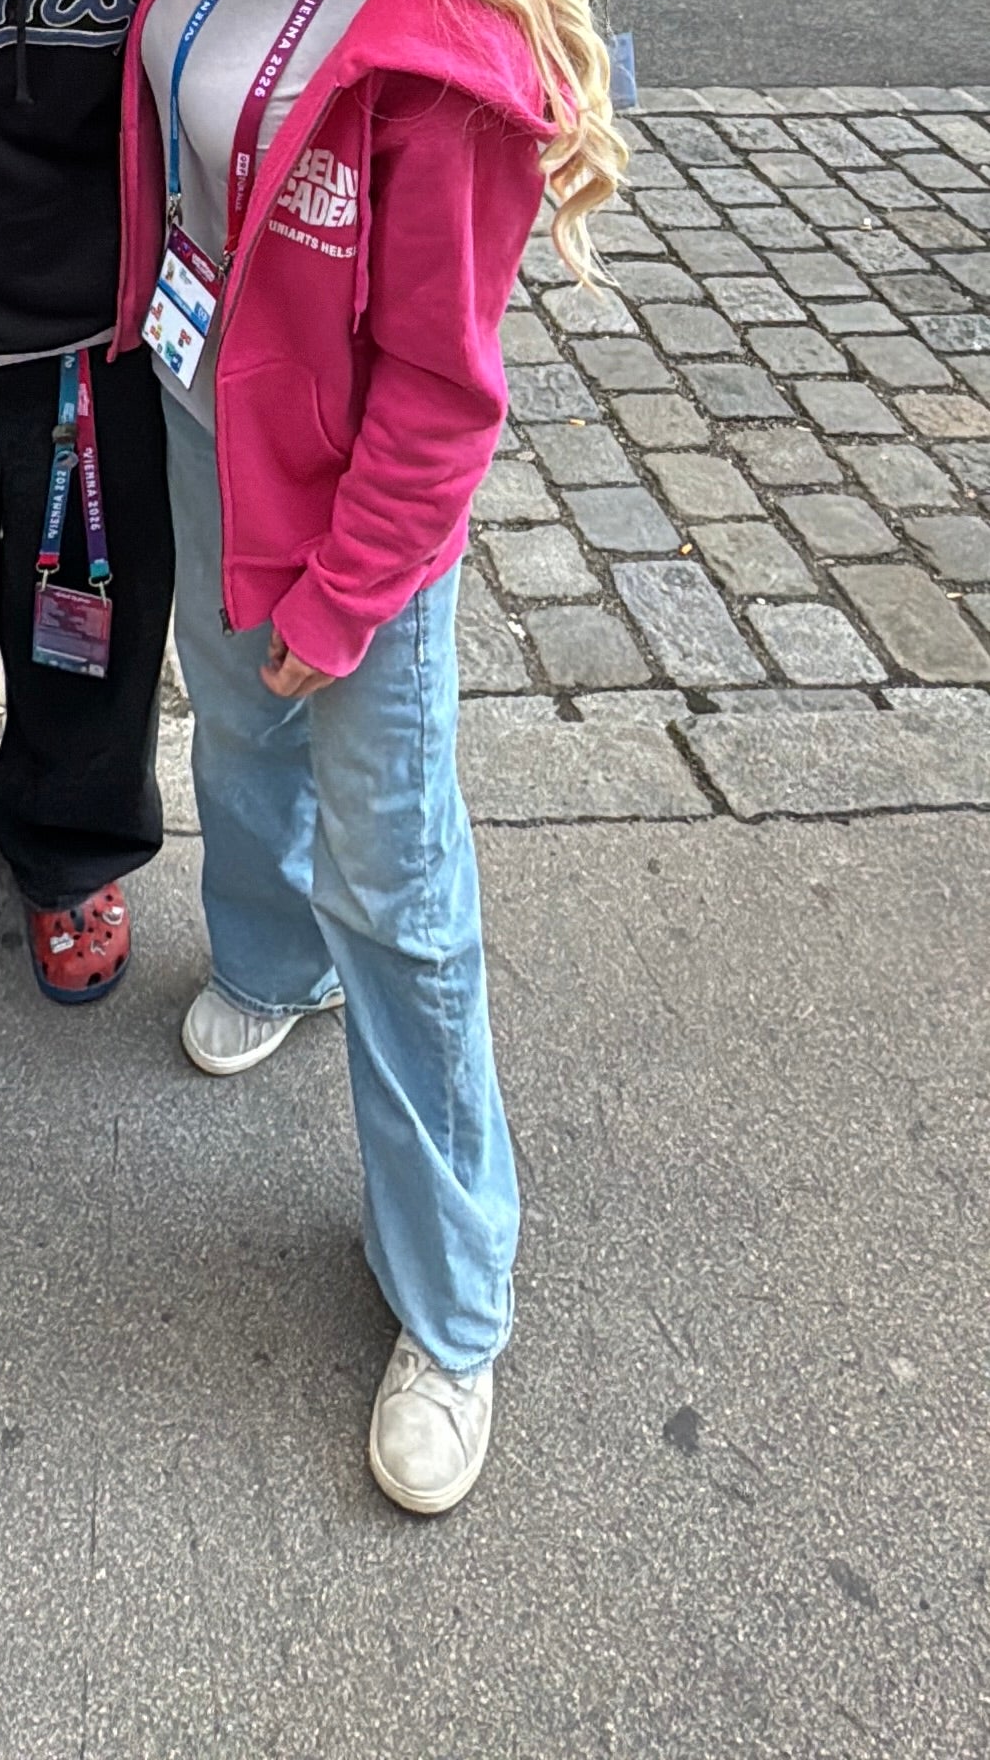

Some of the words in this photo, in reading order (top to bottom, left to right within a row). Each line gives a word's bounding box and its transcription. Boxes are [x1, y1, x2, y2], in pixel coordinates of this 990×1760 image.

[254, 54, 283, 97] 2026
[268, 220, 319, 250] UNIARTS
[54, 470, 67, 492] 202
[83, 447, 97, 497] VIENNA
[47, 494, 64, 539] VIENNA
[87, 500, 102, 531] 2026
